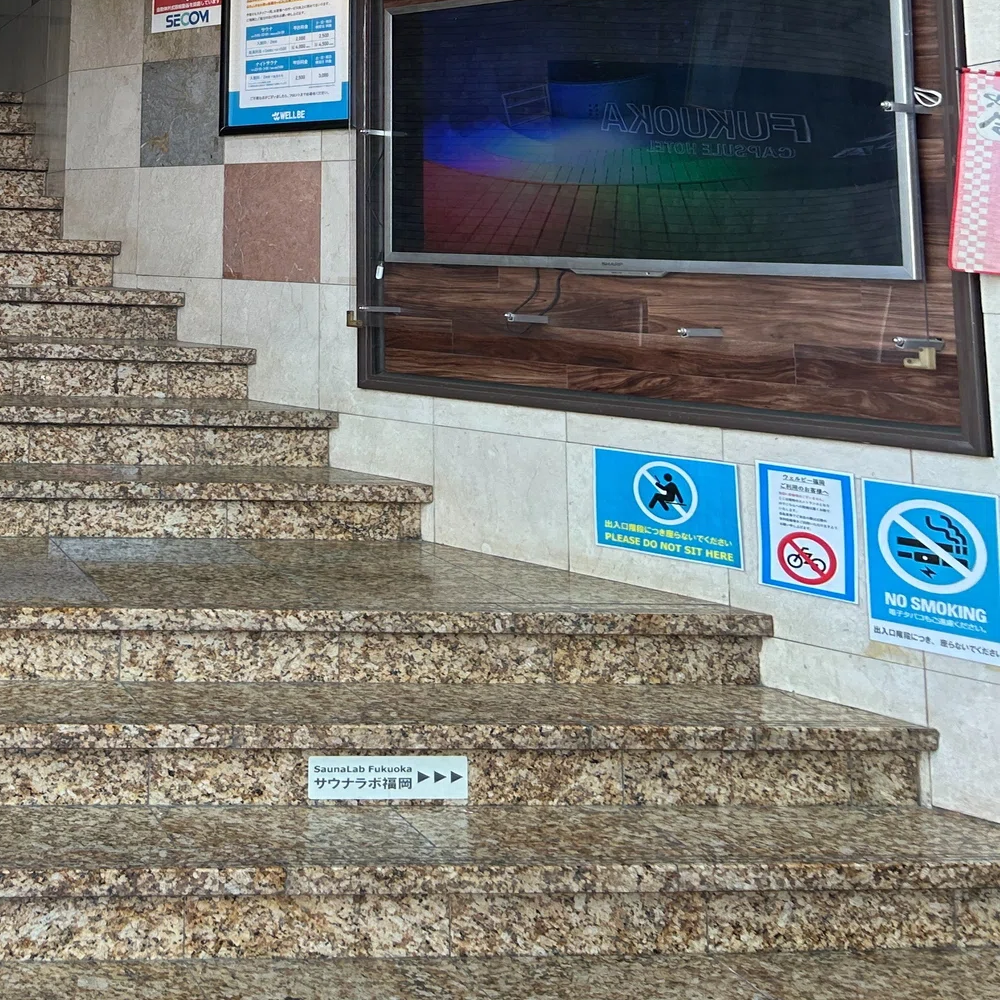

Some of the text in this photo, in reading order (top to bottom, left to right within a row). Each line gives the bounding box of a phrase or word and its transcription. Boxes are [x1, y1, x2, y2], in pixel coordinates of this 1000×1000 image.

[166, 10, 209, 28] SECOM
[280, 110, 305, 119] WELLBE
[604, 519, 733, 547] 出入口階段につき座らないでください
[605, 532, 734, 562] PLEASE DO NOT SIT HERE
[884, 591, 987, 623] NO SMOKING
[313, 765, 412, 773] SaunaLab Fukuoka
[314, 777, 412, 789] サウナラボ福岡
